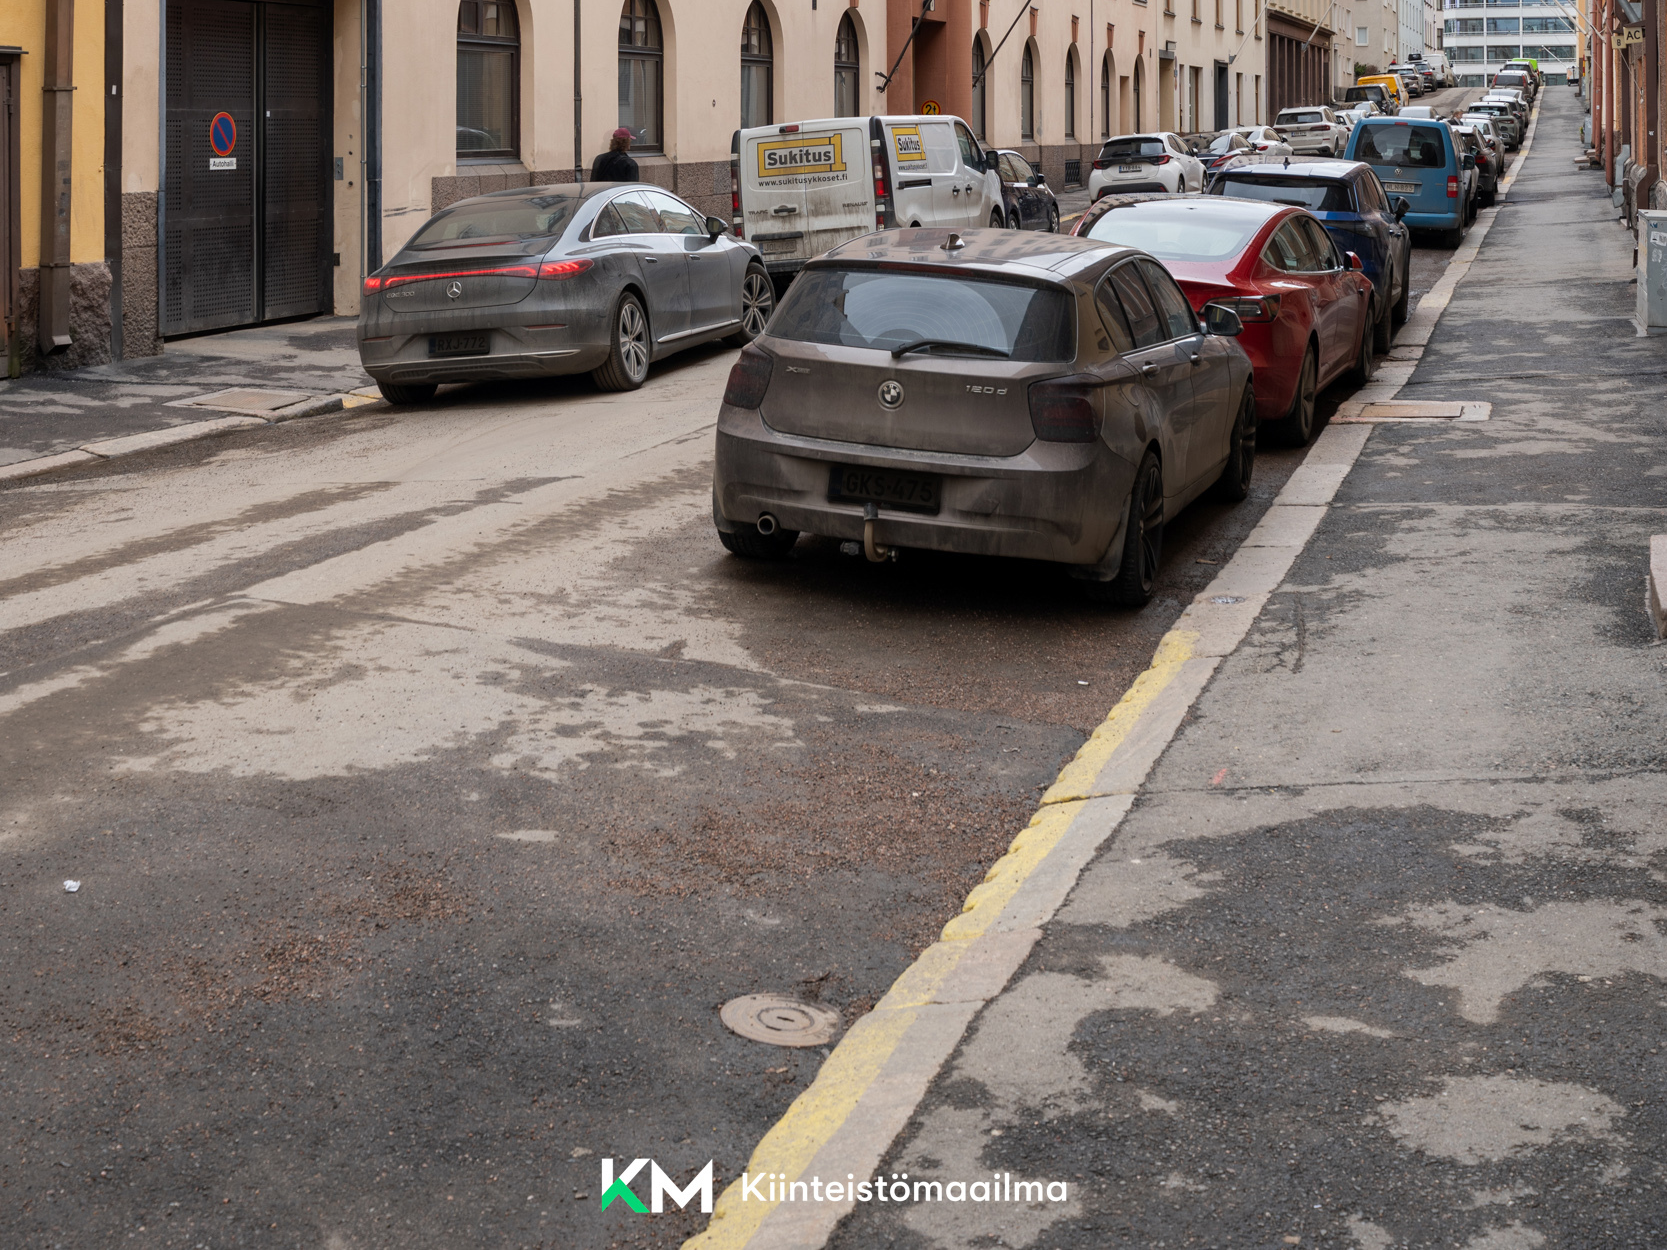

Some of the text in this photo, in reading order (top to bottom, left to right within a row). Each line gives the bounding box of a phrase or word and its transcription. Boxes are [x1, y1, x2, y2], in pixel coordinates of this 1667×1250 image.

[1626, 30, 1641, 40] AC
[897, 137, 920, 151] Sukitus
[767, 149, 832, 166] Sukitus
[758, 173, 848, 187] www.sukitusykkoset.fi
[437, 337, 486, 351] RXJ-772
[846, 472, 932, 502] GKS-475
